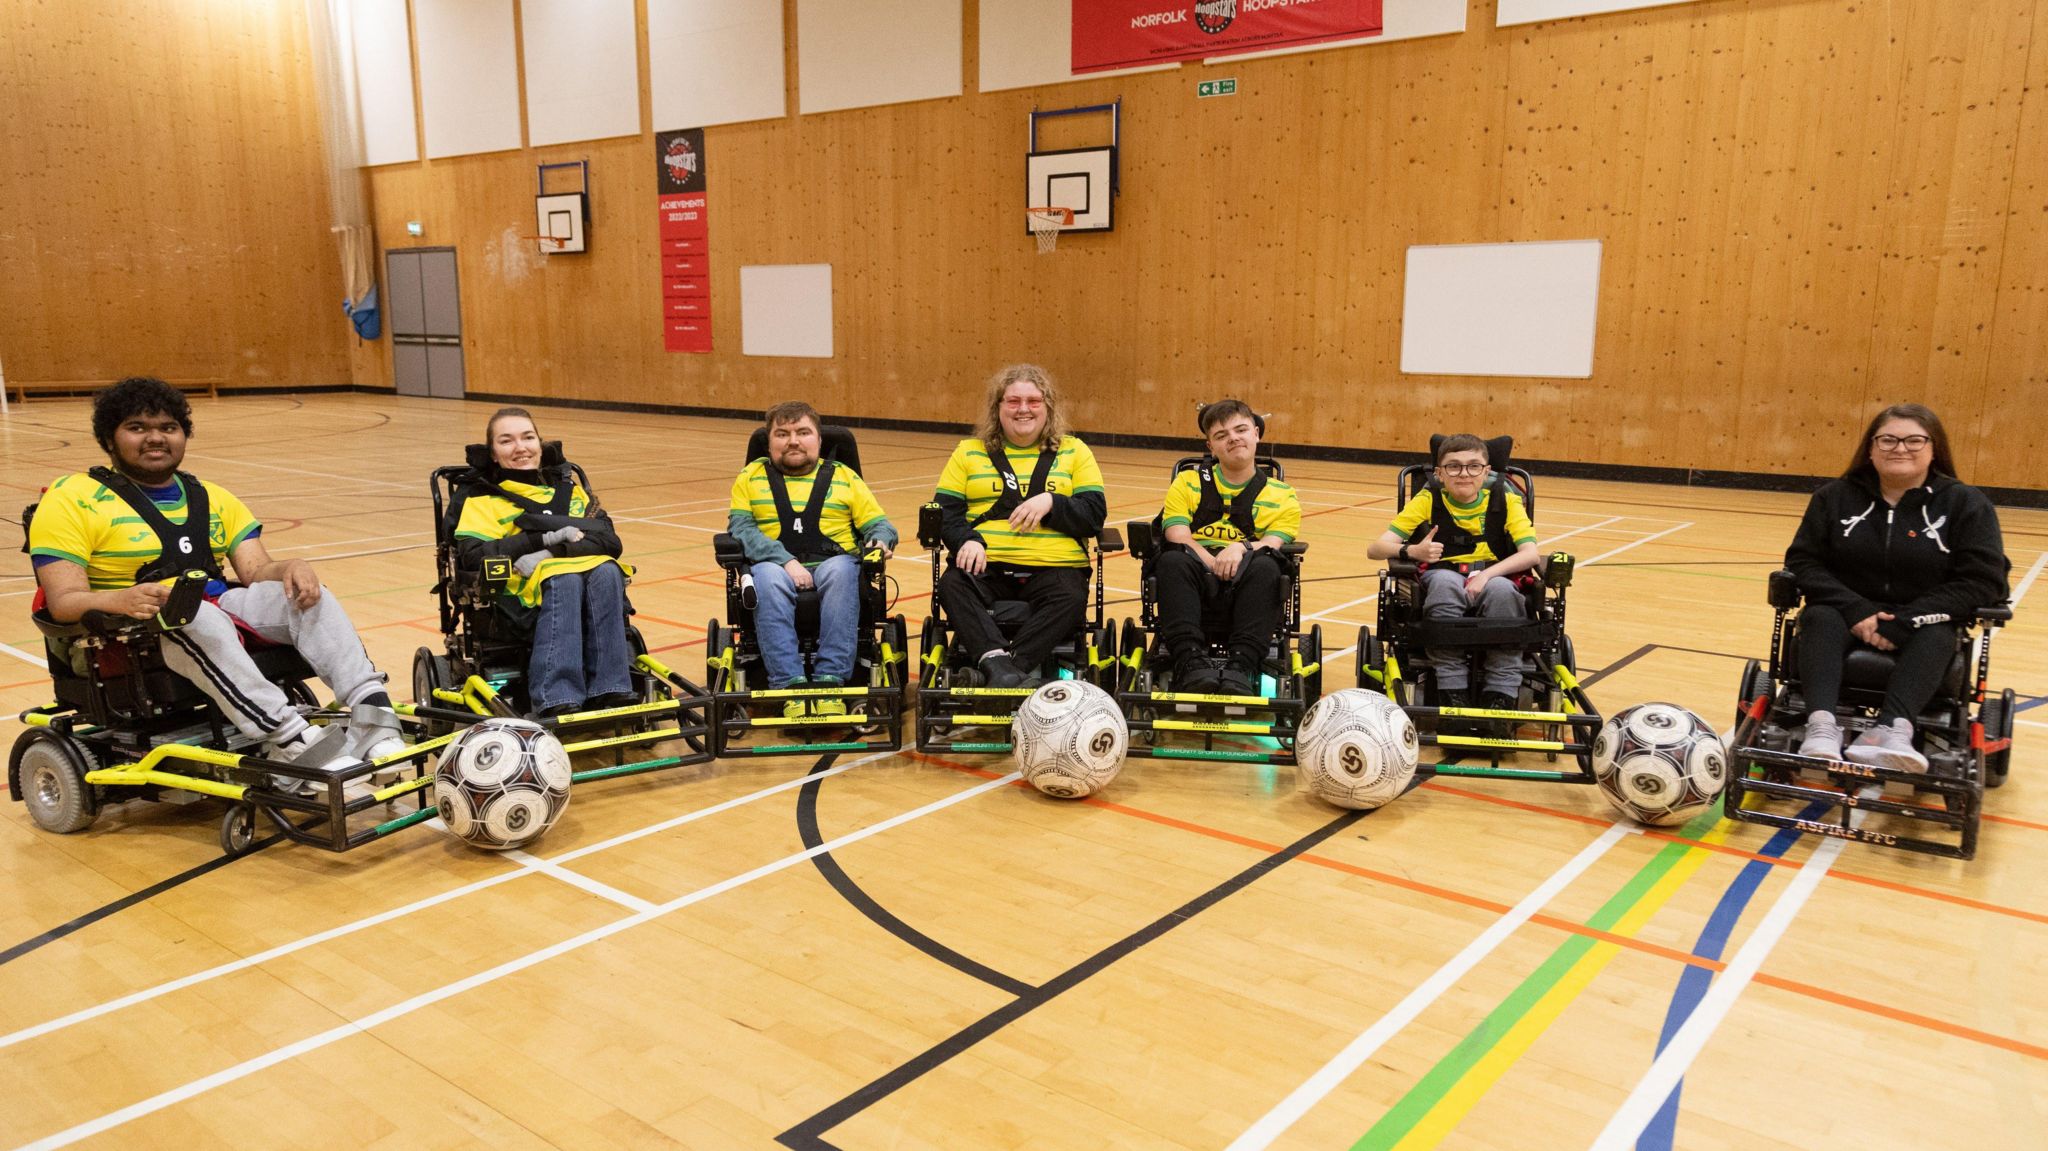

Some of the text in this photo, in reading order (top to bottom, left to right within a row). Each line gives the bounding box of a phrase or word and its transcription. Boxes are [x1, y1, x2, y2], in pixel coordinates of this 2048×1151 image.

[1131, 9, 1187, 28] NORFOLK
[661, 199, 705, 209] ACHIEVEMENTS
[992, 481, 1056, 493] LTS
[1002, 471, 1018, 490] 20
[793, 517, 804, 534] 4
[179, 535, 193, 554] 6
[863, 549, 882, 563] 4
[1552, 553, 1568, 563] 21
[490, 564, 506, 575] 3
[1795, 820, 1858, 839] ASPIRE
